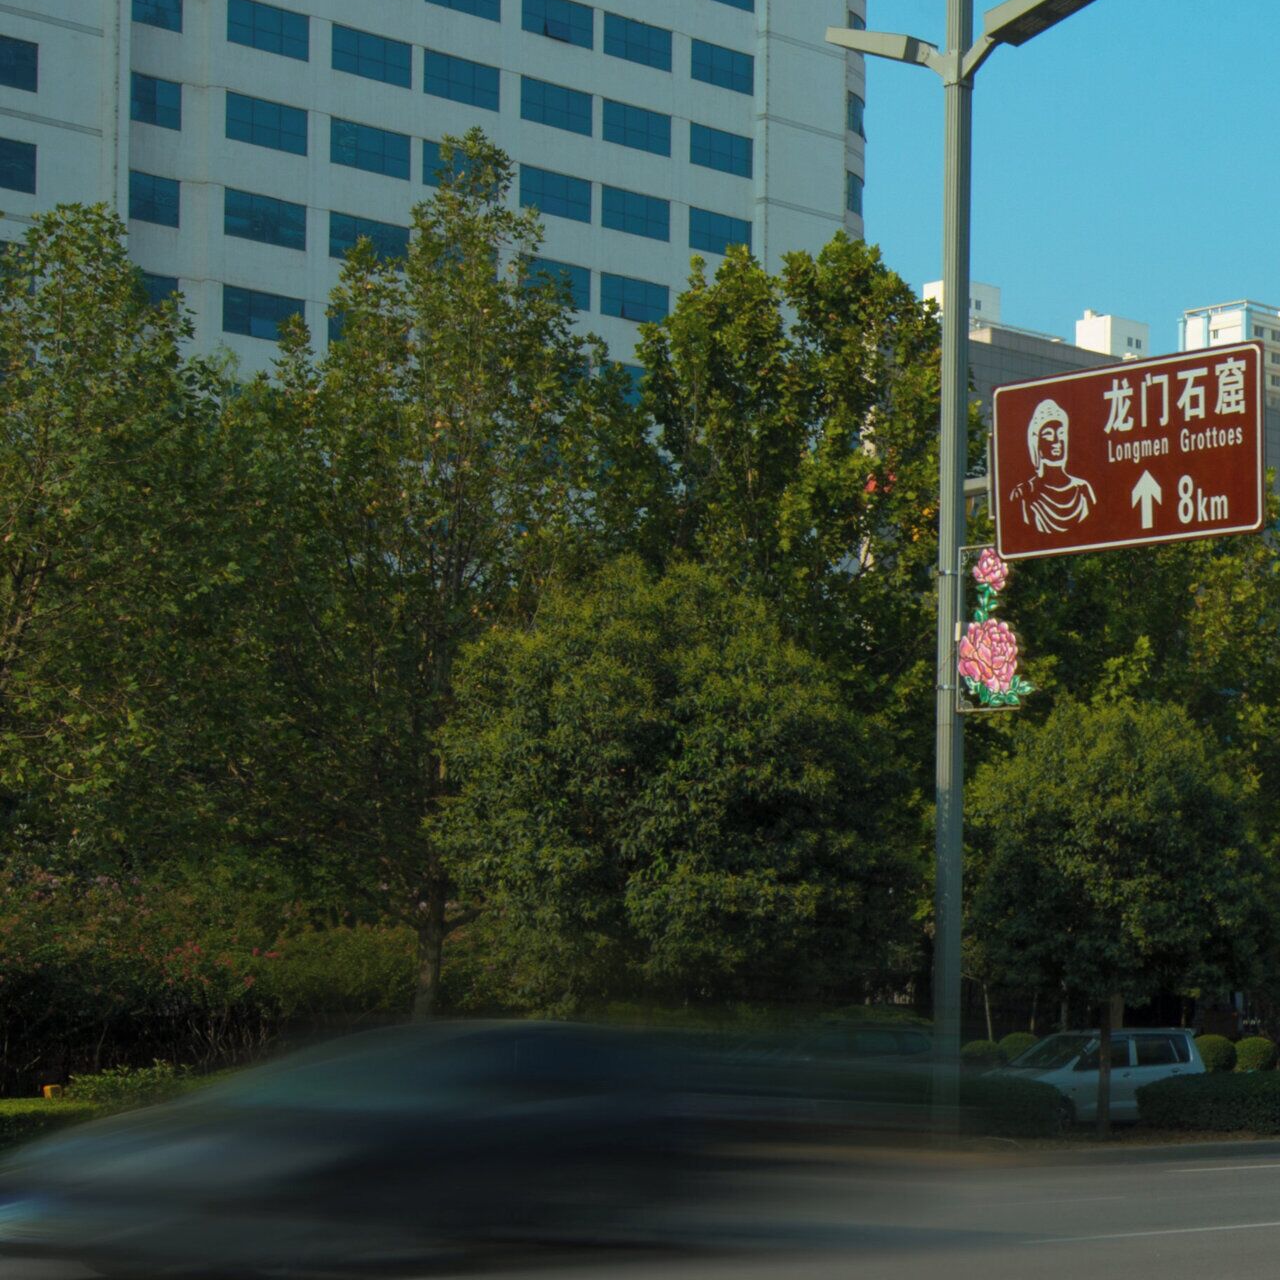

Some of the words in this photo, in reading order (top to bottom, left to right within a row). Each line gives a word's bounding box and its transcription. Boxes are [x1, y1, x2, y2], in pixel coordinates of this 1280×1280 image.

[1103, 357, 1247, 434] 龙门石窟
[1108, 437, 1169, 463] Longmen
[1180, 427, 1243, 453] Grottoes
